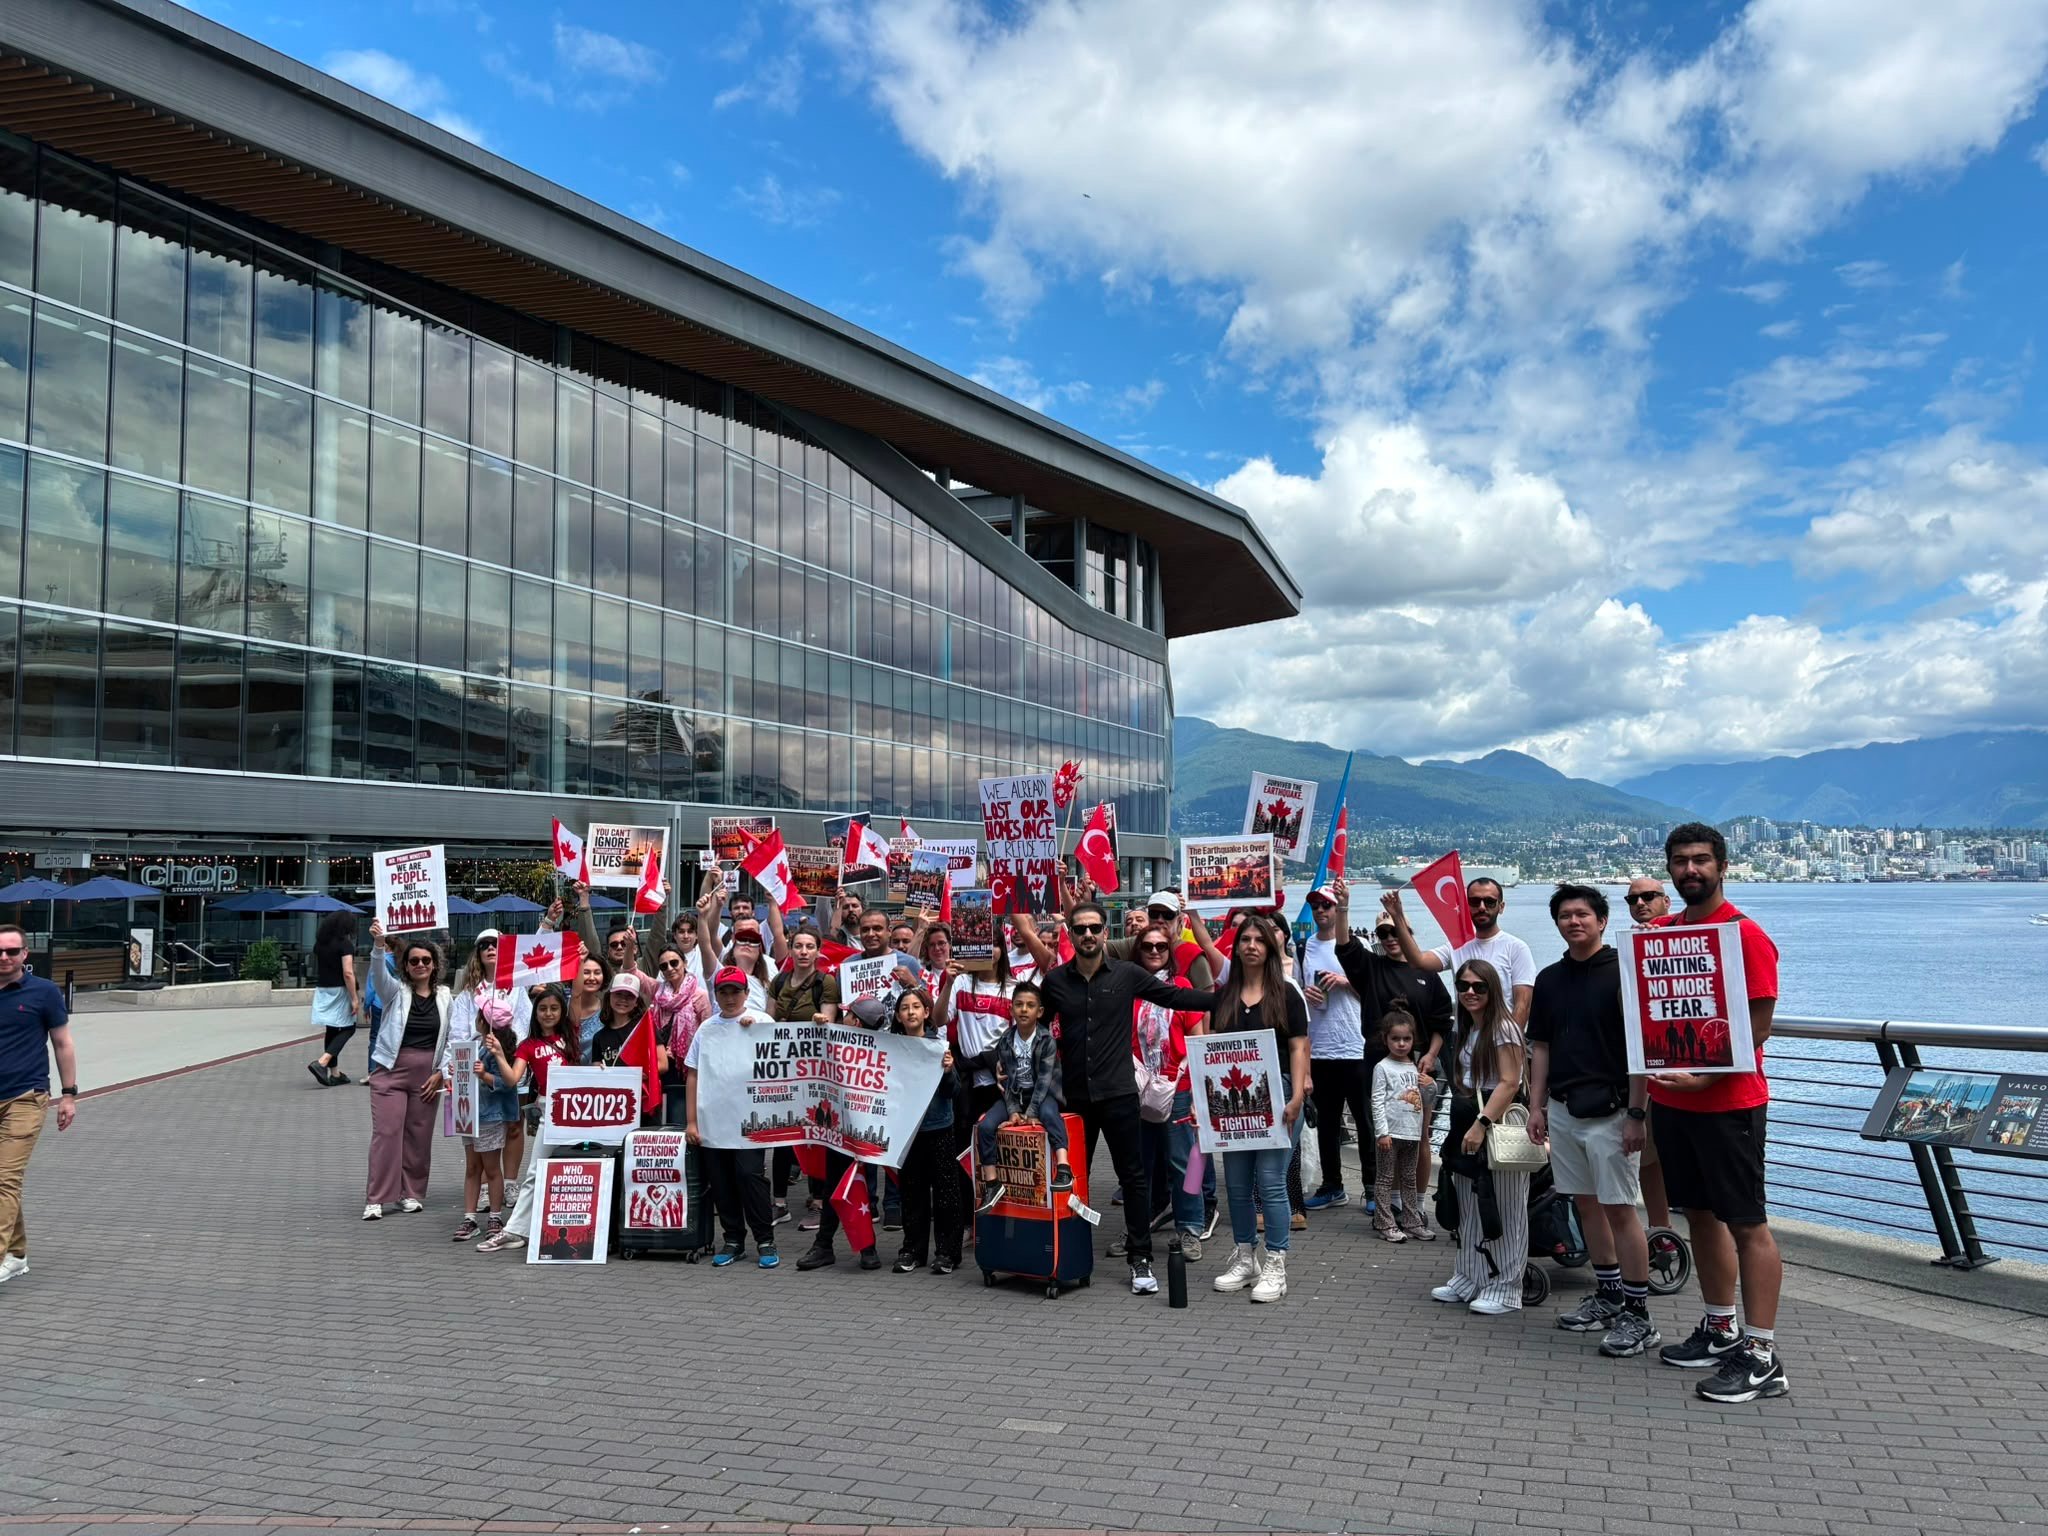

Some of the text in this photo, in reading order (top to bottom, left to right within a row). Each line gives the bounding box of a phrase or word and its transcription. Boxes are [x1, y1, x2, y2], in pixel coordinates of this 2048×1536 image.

[984, 779, 1047, 800] WE ALREADY
[1267, 779, 1302, 791] SURVIVED THE
[982, 800, 1052, 820] LOST OUR
[596, 828, 630, 838] YOU CAN'T
[752, 826, 768, 834] HERE
[985, 819, 1055, 840] HOMES ONCE
[594, 836, 630, 848] IGNORE
[1273, 836, 1291, 849] TING
[958, 845, 976, 856] HAS
[986, 840, 1056, 859] WE REFUSE TO
[1190, 846, 1201, 855] The
[1202, 844, 1241, 857] Earthquake
[1250, 844, 1268, 852] Over.
[592, 855, 622, 868] LIVES
[812, 856, 838, 864] FAMILIES
[989, 859, 1012, 875] LOSE
[1026, 858, 1055, 875] AGAIN
[1190, 854, 1228, 866] The Pain
[397, 862, 422, 872] WE ARE
[141, 859, 238, 893] chop
[391, 869, 431, 885] PEOPLE,
[404, 883, 416, 891] NOT
[392, 890, 430, 902] STATISTICS.
[1644, 936, 1710, 956] NO MORE
[850, 960, 884, 973] WE ALREADY
[1647, 956, 1712, 976] WAITING.
[856, 970, 868, 979] LOST
[1648, 977, 1714, 998] NO MORE
[1662, 999, 1708, 1018] FEAR.
[774, 1028, 876, 1048] MR. PRIME MINISTER,
[1206, 1038, 1258, 1052] SURVIVED THE
[756, 1041, 890, 1072] WE ARE PEOPLE,
[1204, 1048, 1264, 1065] EARTHQUAKE.
[753, 1059, 888, 1090] NOT STATISTICS.
[747, 1084, 799, 1094] WE SURVIVED THE
[808, 1082, 816, 1090] WE
[753, 1094, 796, 1104] EARTHQUAKE.
[808, 1090, 818, 1098] FOR
[844, 1092, 885, 1106] HUMANITY HAS
[560, 1093, 627, 1121] TS2023
[850, 1102, 870, 1114] EXPIRY
[872, 1106, 888, 1116] DATE.
[1219, 1115, 1267, 1132] FIGHTING
[632, 1134, 682, 1145] HUMANITARIAN
[802, 1125, 843, 1147] TS2023
[1220, 1130, 1272, 1140] FOR OUR FUTURE.
[1016, 1136, 1038, 1148] ERASE
[634, 1146, 678, 1157] EXTENSIONS
[636, 1158, 674, 1168] MUST APPLY
[1022, 1149, 1040, 1170] OF
[563, 1166, 583, 1175] WHO
[637, 1170, 676, 1182] EQUALLY.
[1008, 1168, 1036, 1186] WORK
[552, 1175, 594, 1185] APPROVED
[550, 1194, 592, 1202] OF CANADIAN
[550, 1202, 592, 1212] CHILDREN?
